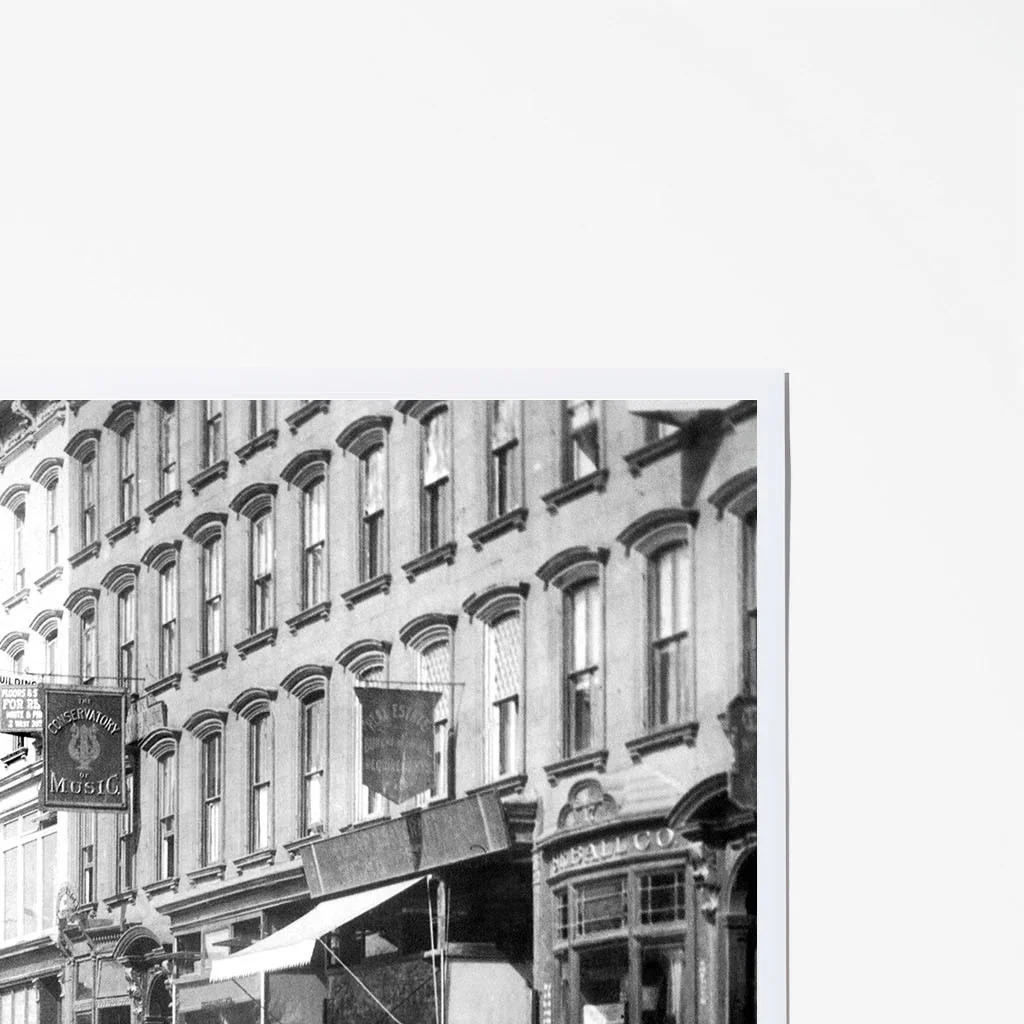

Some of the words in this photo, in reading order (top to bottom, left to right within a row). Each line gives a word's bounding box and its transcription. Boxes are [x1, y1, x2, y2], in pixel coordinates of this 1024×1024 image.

[2, 698, 24, 710] FOR
[26, 698, 41, 710] RE
[47, 707, 121, 735] CONSERVATORY
